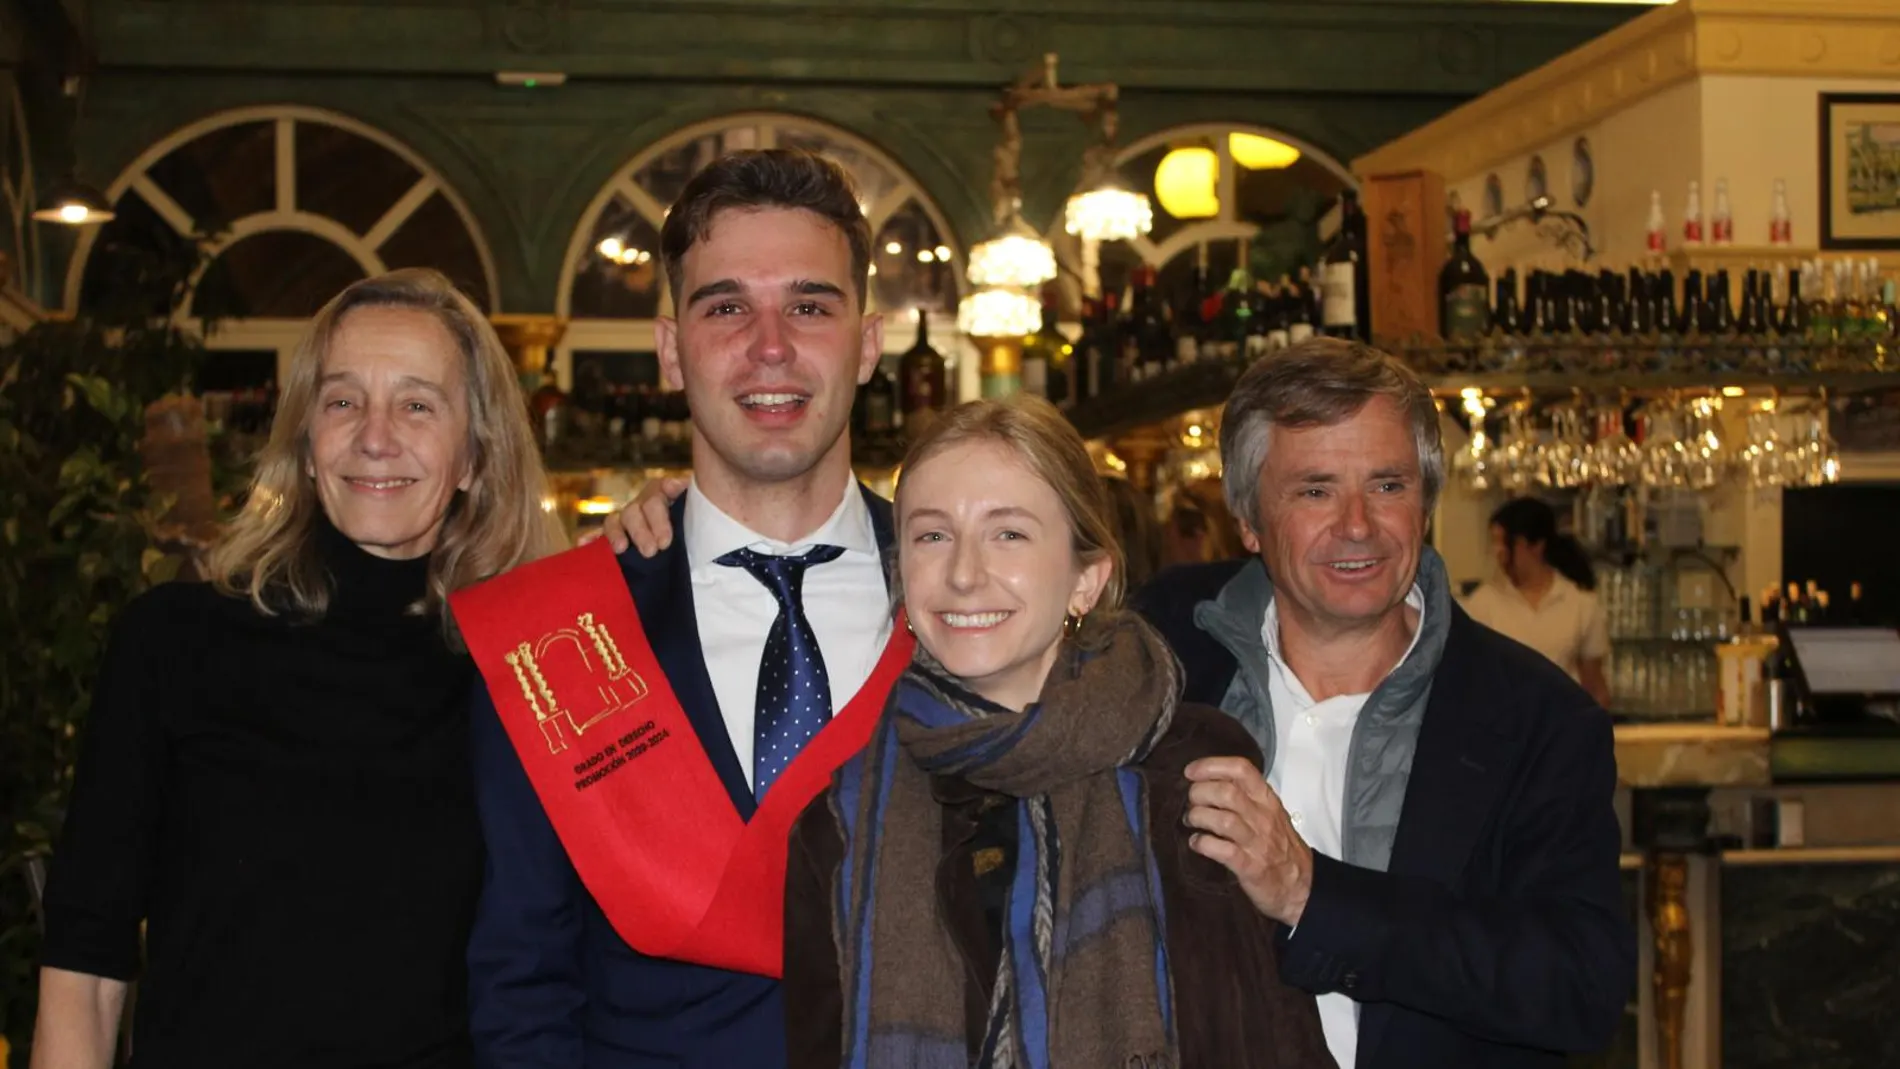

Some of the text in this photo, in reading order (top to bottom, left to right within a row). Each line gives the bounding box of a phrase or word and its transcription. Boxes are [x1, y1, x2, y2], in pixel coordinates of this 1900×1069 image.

[574, 752, 604, 774] GRADO
[604, 744, 617, 756] EN
[575, 756, 626, 792] PROMOCIÓN
